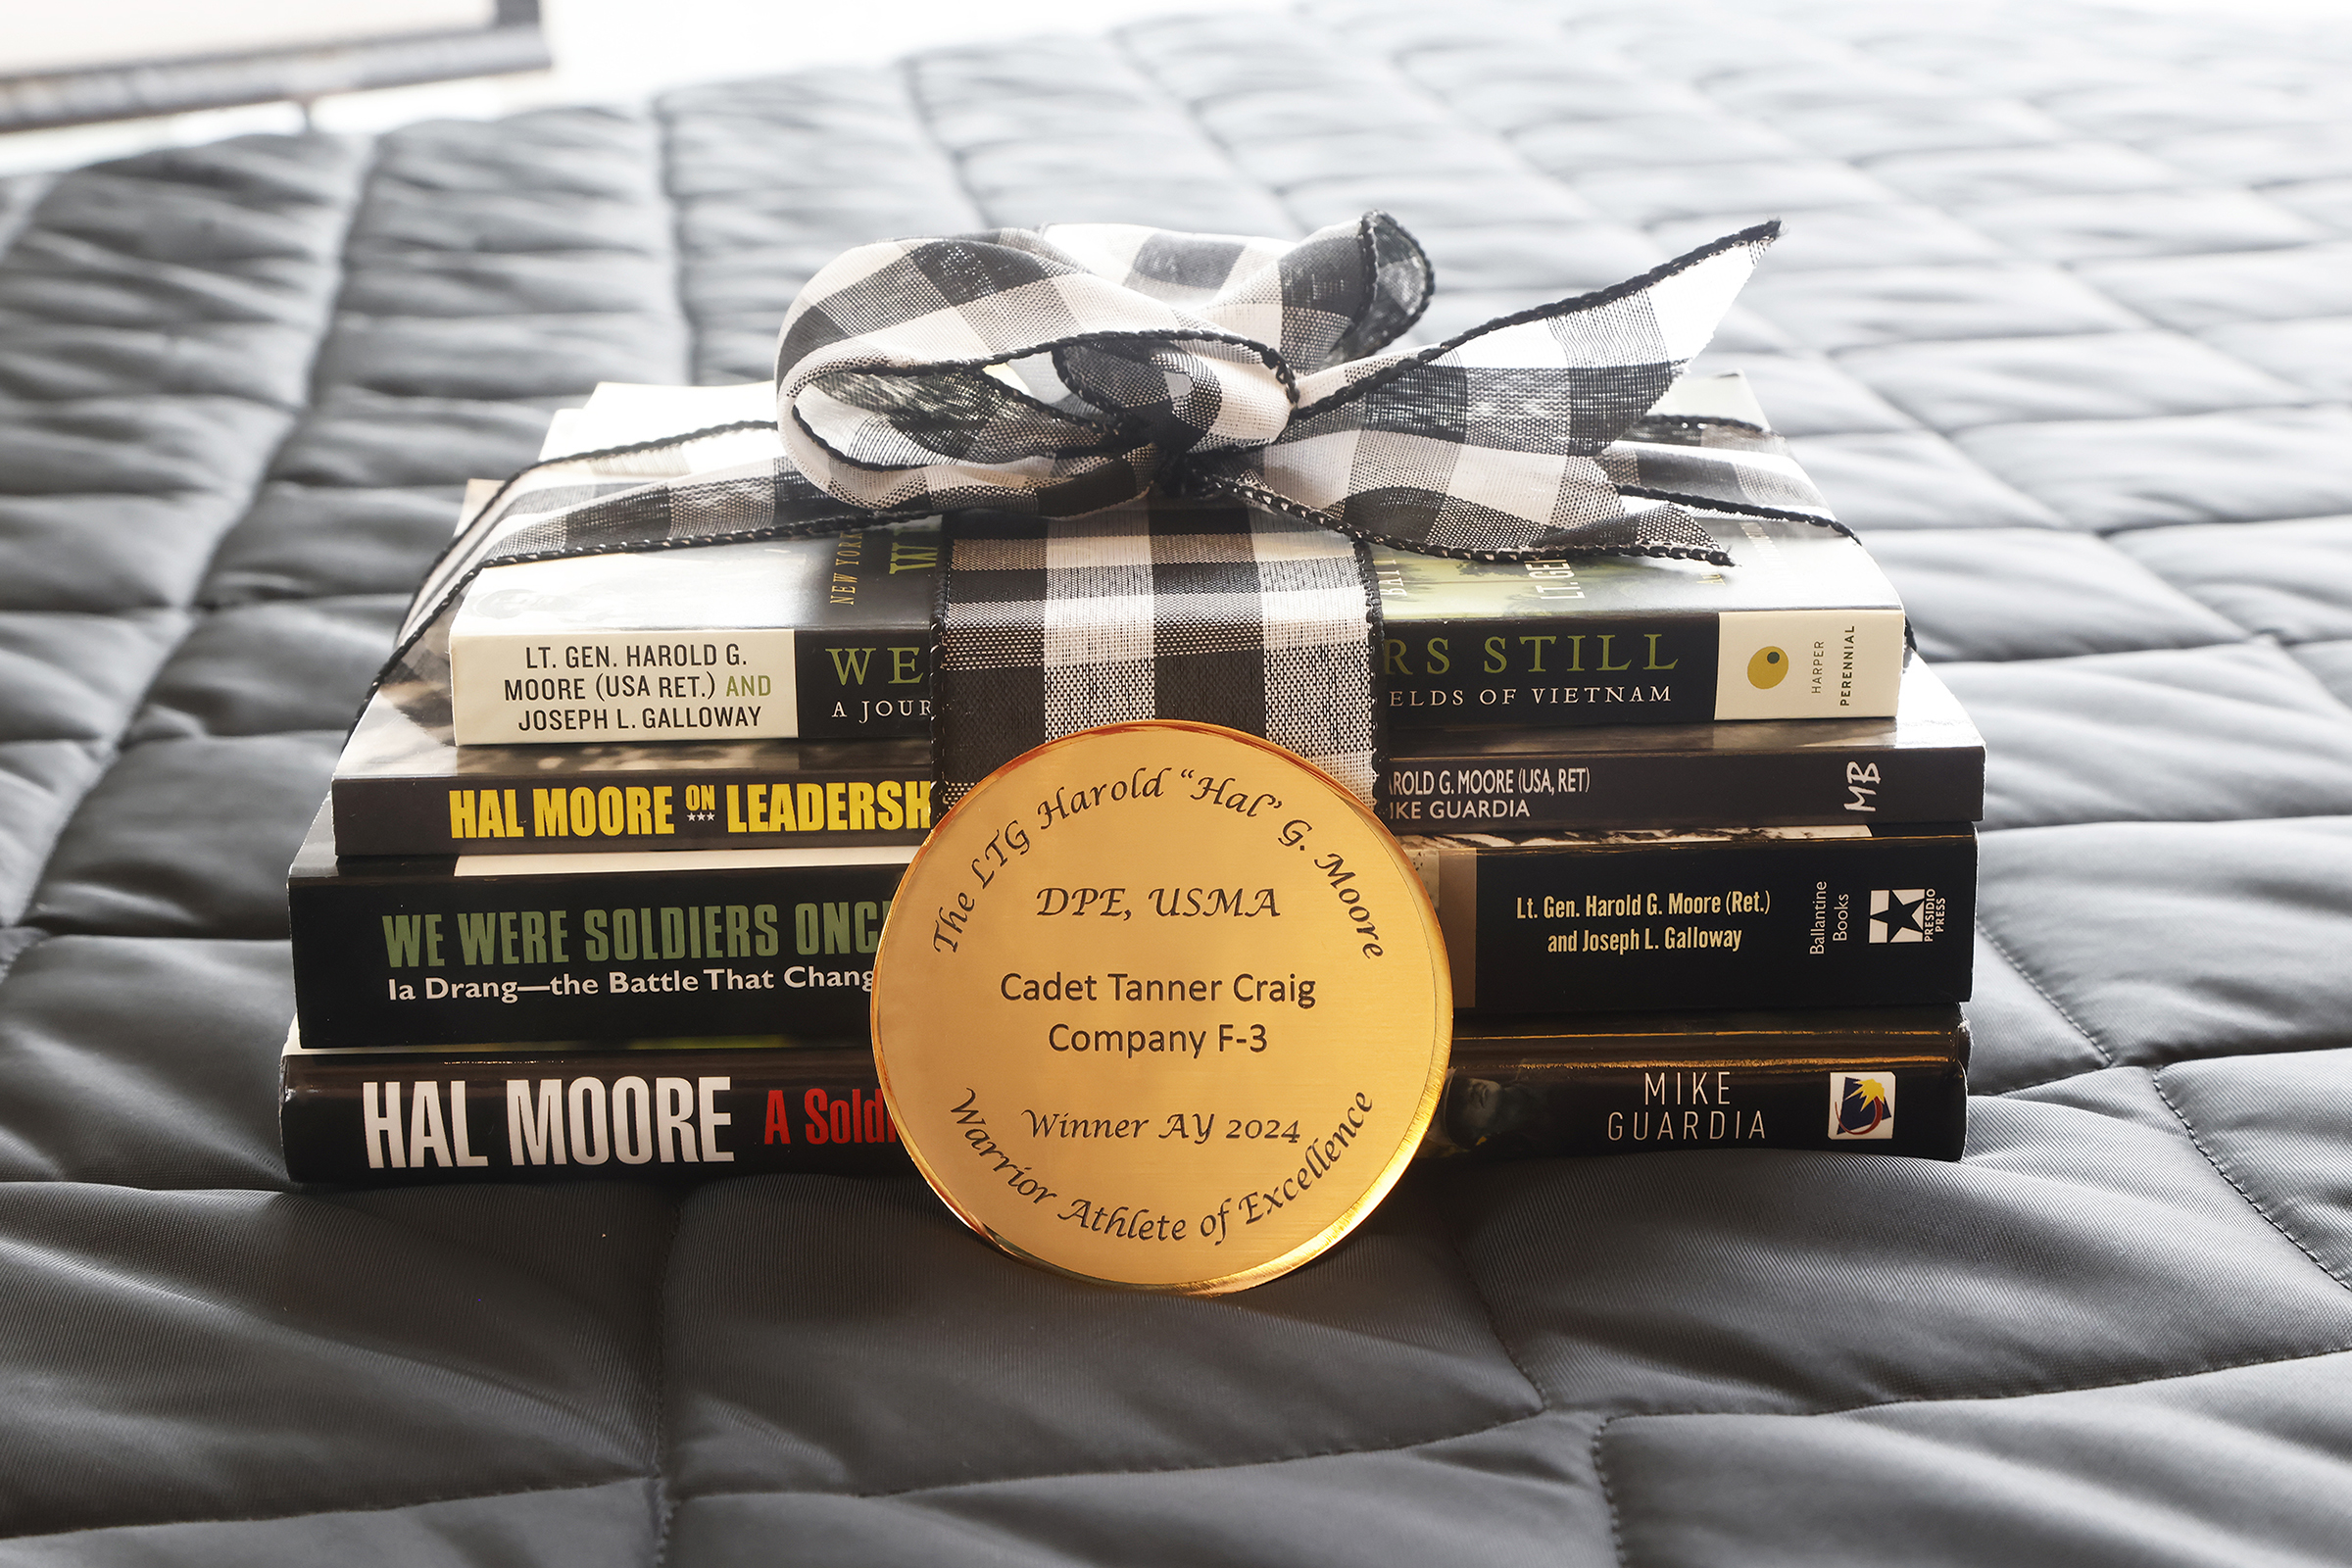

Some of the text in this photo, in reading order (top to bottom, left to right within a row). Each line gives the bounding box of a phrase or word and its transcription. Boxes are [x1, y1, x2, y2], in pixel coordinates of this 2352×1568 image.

[1523, 558, 1577, 579] GE
[830, 572, 858, 606] NEW
[525, 643, 748, 669] LT. GEN. HAROLD G.
[1484, 632, 1680, 674] STILL
[1811, 639, 1826, 695] HARPER
[1839, 624, 1855, 707] PERENNIAL
[505, 672, 771, 703] MOORE (USA RET.) AND
[1479, 688, 1517, 706] OF
[1531, 685, 1673, 706] VIETNAM
[518, 705, 762, 732] JOSEPH L. GALLOWAY
[832, 701, 847, 717] A
[1389, 765, 1592, 796] ROLD G. MOORE (USA, RET)
[449, 788, 526, 840] HAL
[534, 785, 676, 838] MOORE
[685, 784, 716, 812] ON
[1430, 799, 1532, 819] GUARDIA
[932, 892, 976, 956] The
[971, 820, 1032, 890] LTG
[1037, 766, 1171, 829] Harold
[1279, 818, 1313, 852] G.
[1314, 851, 1385, 959] Moore
[1036, 886, 1282, 921] DPE, USMA
[1516, 888, 1771, 920] Lt. Gen. Harold G. Moore (Ret.)
[1809, 881, 1828, 956] Ballantine
[1833, 893, 1849, 942] Books
[1924, 888, 1936, 943] PRESIDIO
[1935, 897, 1946, 932] PRESS
[382, 900, 892, 969] WE WERE SOLDIERS ONC
[1547, 924, 1742, 956] and Joseph L. Galloway
[609, 969, 699, 995] Battle
[703, 966, 774, 992] That
[1000, 972, 1316, 1009] Cadet Tanner Craig
[1048, 1023, 1268, 1058] Company F-3
[1644, 1070, 1732, 1106] MIKE
[362, 1075, 735, 1169] HAL MOORE
[763, 1089, 791, 1146] A
[1021, 1107, 1301, 1147] Winner AY 2024
[1607, 1109, 1767, 1142] GUARDIA
[950, 1086, 1375, 1247] Warrior Athlete of Excellence
